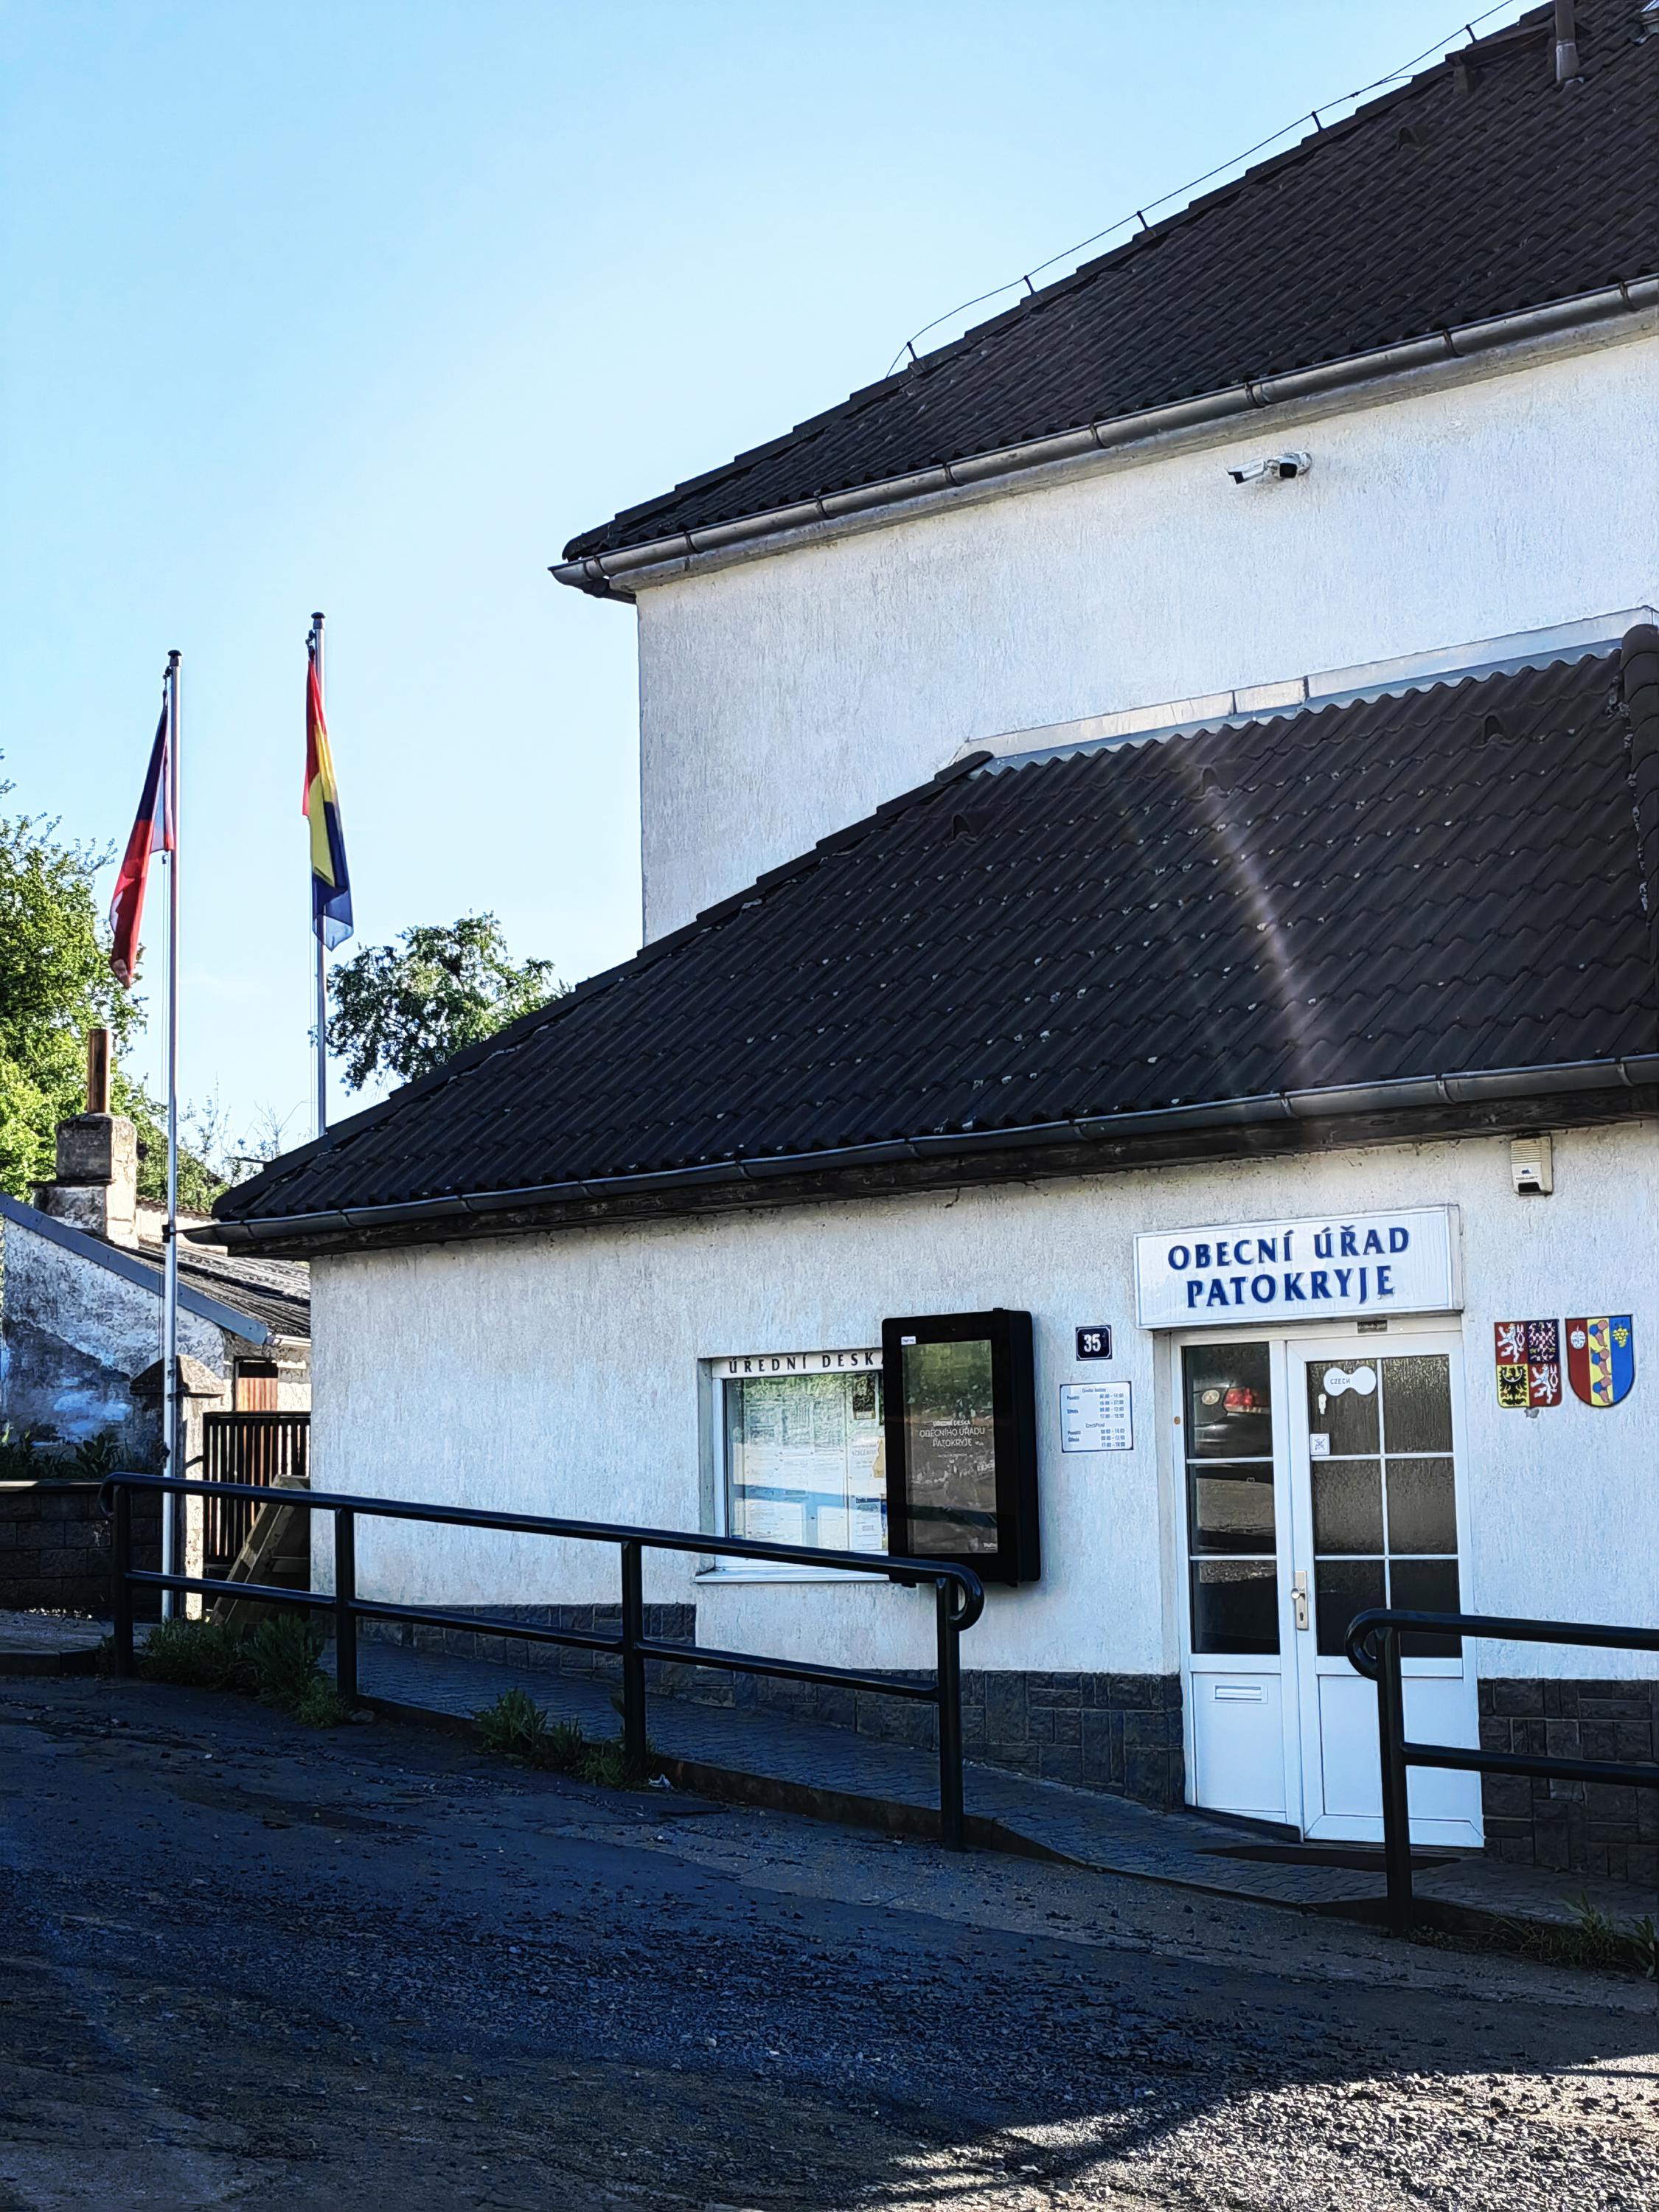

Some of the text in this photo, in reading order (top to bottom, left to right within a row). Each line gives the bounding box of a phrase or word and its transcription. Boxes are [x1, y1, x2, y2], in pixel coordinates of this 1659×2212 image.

[1168, 1225, 1410, 1270] OBECNÍ ÚŘAD
[1186, 1265, 1395, 1309] PATOKRYJE
[1084, 1333, 1102, 1352] 35
[728, 1352, 884, 1374] ÚŘEDNÍ DESK
